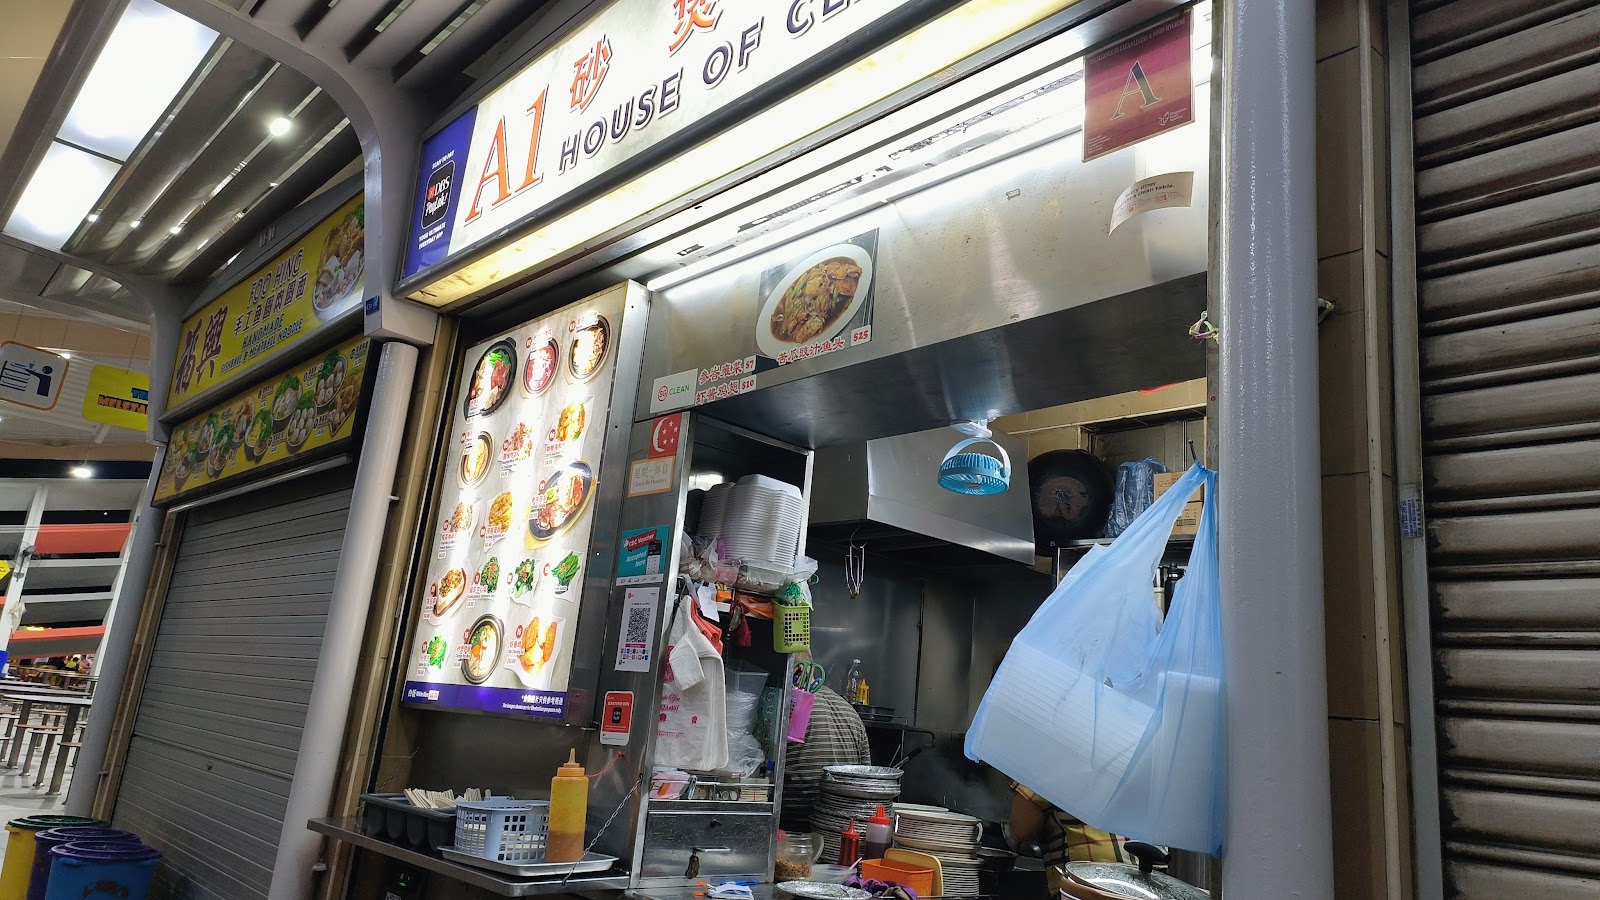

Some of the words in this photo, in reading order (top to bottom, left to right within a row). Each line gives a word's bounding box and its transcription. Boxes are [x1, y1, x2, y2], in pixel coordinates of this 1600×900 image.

[1120, 34, 1148, 52] CLEANLINESS
[1152, 26, 1166, 38] FOOD
[570, 39, 610, 109] 砂
[559, 71, 682, 171] HOUSE
[702, 22, 761, 85] OF
[1109, 59, 1162, 121] A
[464, 86, 548, 225] A1
[434, 176, 450, 196] DBS
[1138, 187, 1154, 197] clean
[1155, 183, 1175, 191] table.
[1140, 181, 1157, 190] diner
[247, 271, 273, 308] FOO
[272, 247, 304, 291] HING
[241, 313, 285, 352] HANDMADE
[853, 330, 869, 342] $25
[745, 359, 754, 369] $7
[670, 384, 690, 396] CLEAN
[741, 379, 755, 390] $10
[98, 394, 149, 414] MELETA
[628, 538, 638, 547] CDC
[626, 550, 648, 563] Accepted
[635, 559, 646, 568] here
